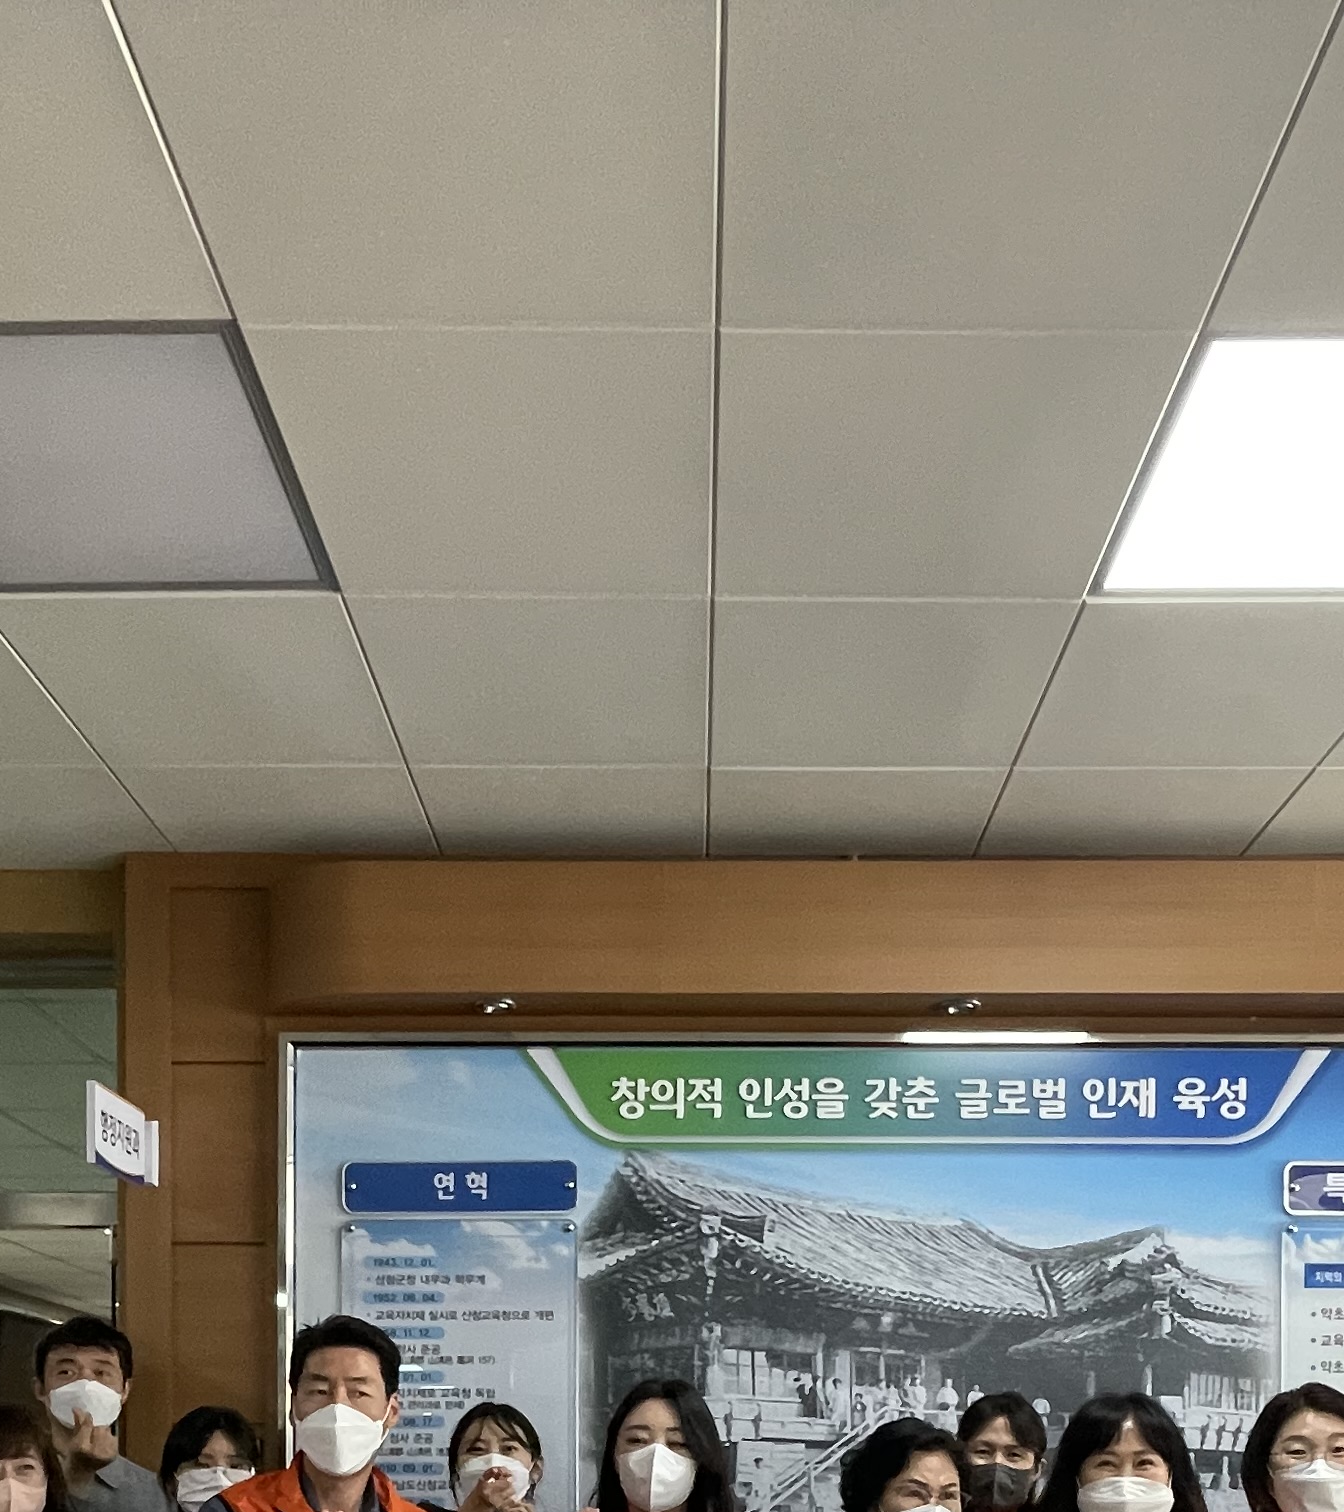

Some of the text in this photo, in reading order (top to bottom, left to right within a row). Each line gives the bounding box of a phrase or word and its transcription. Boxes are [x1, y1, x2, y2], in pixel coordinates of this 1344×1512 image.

[609, 1076, 1250, 1121] 창의적 인성을 갖춘 글로벌 인재 육성
